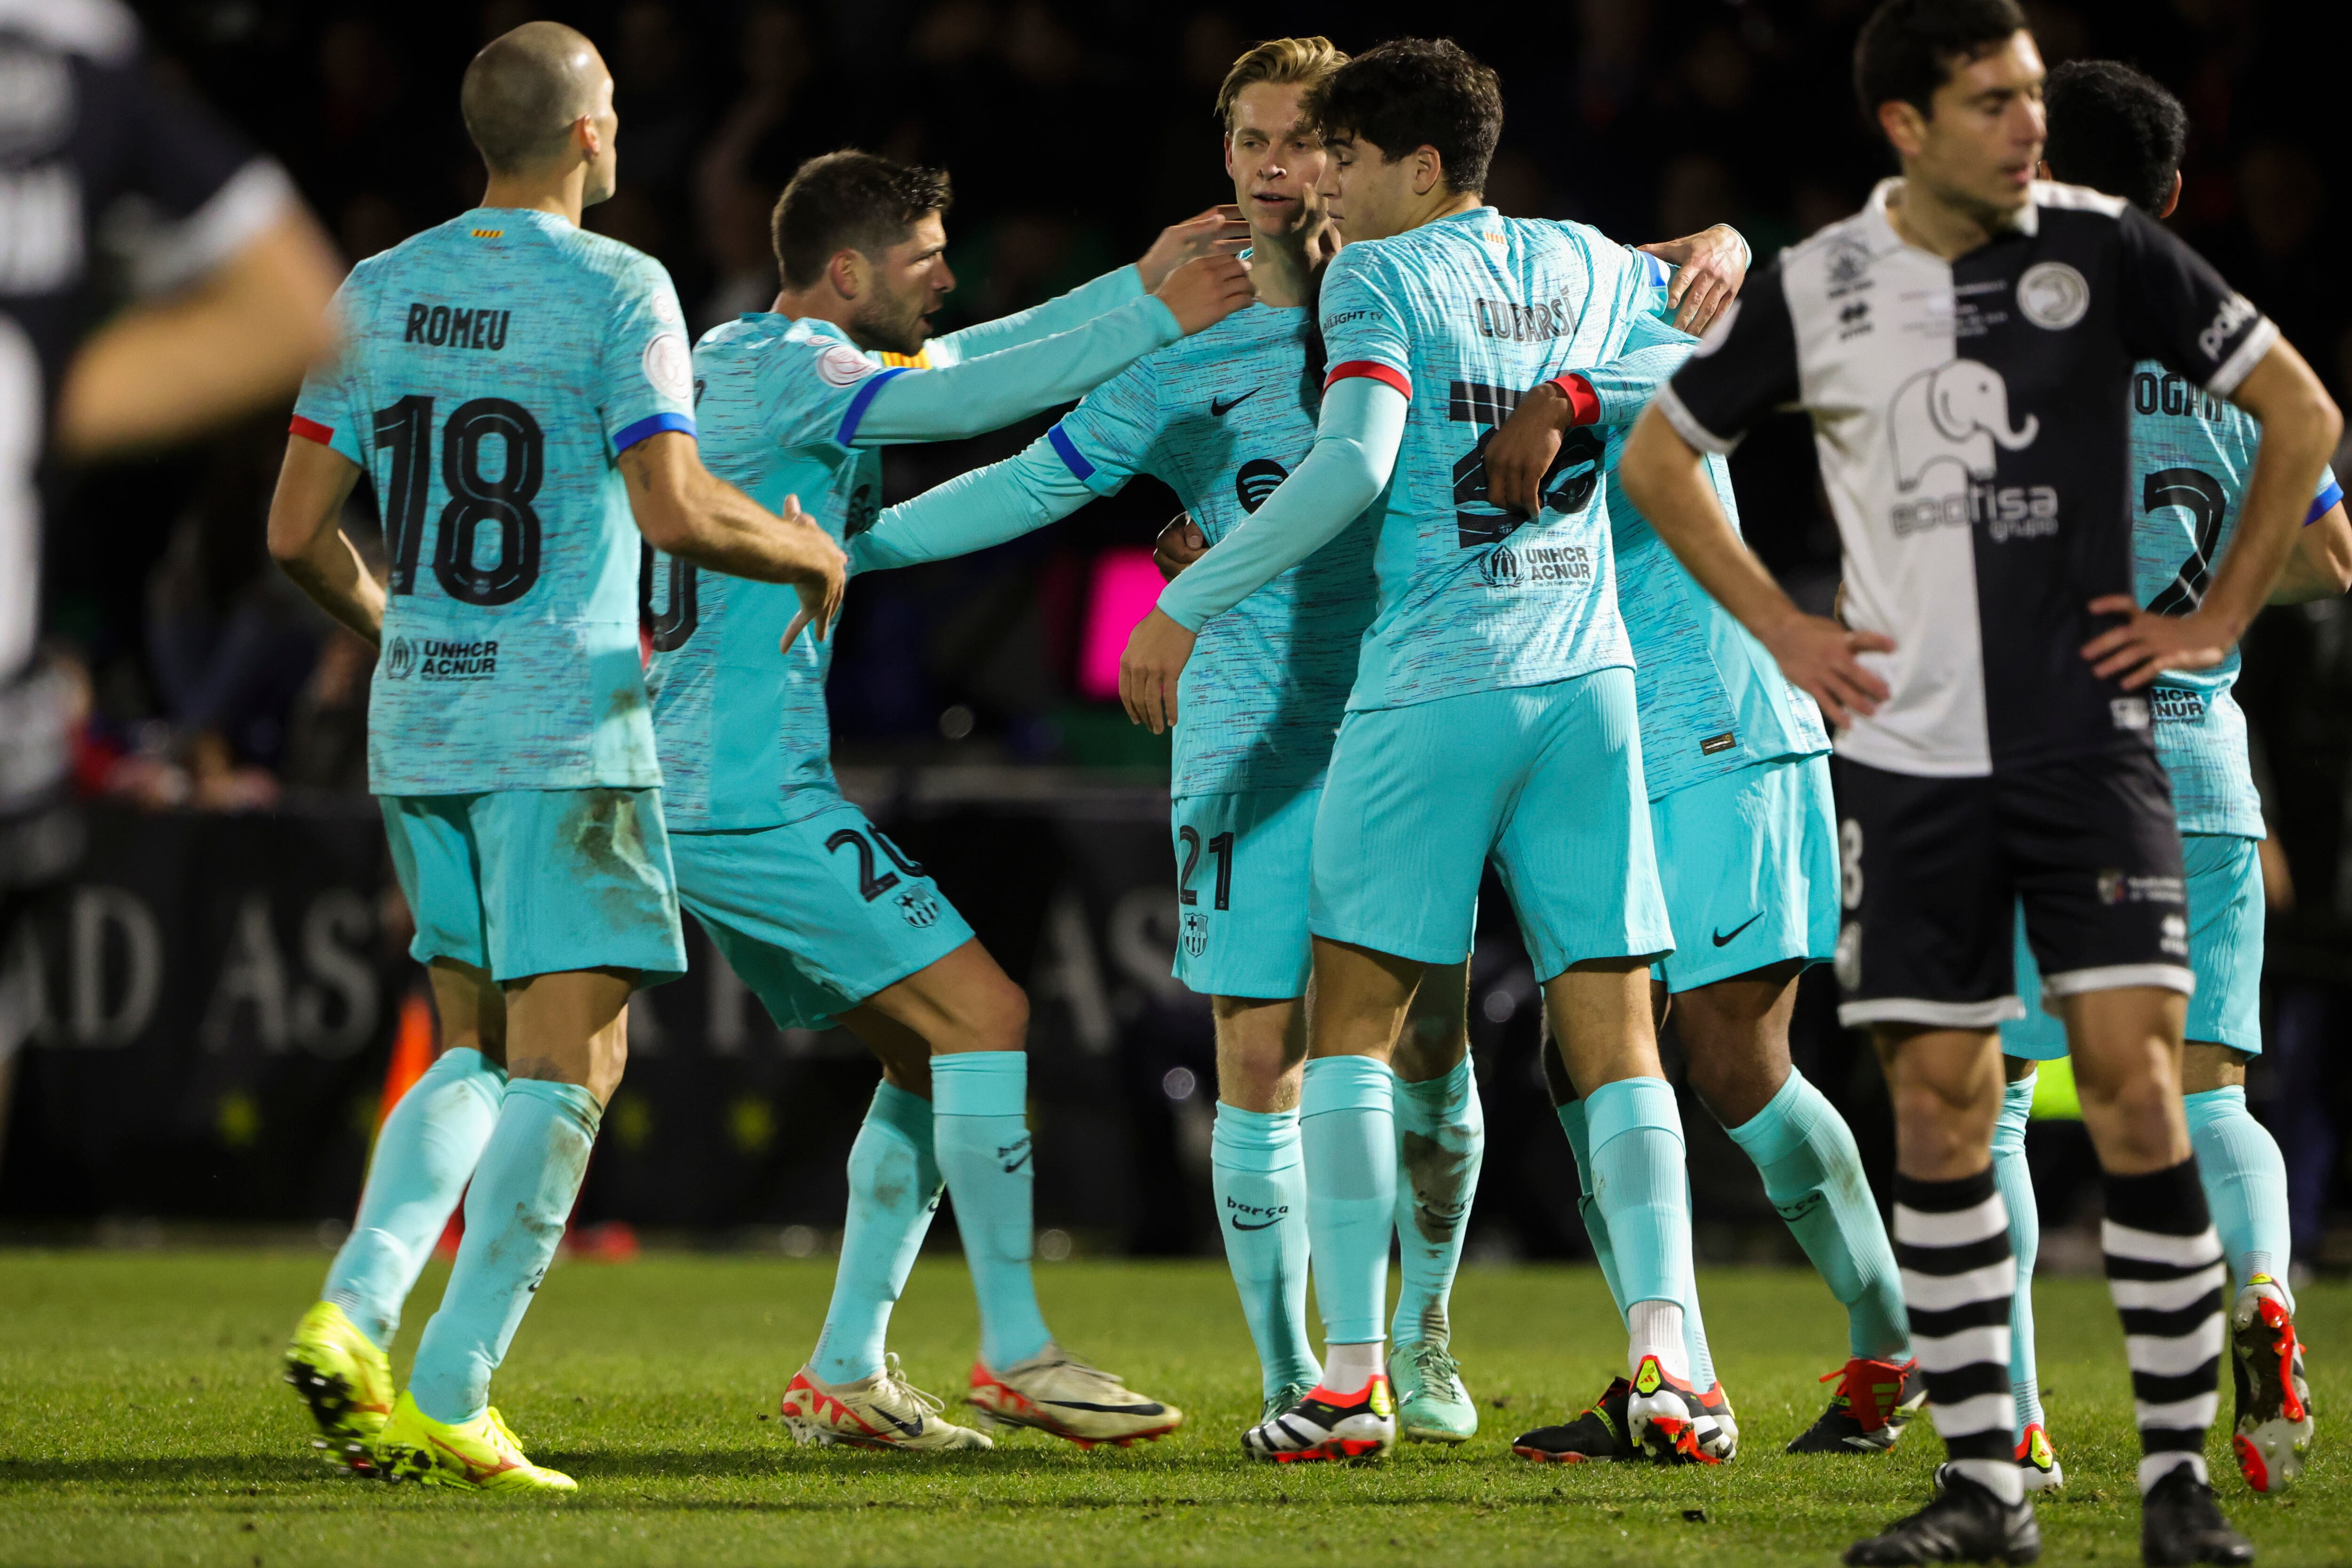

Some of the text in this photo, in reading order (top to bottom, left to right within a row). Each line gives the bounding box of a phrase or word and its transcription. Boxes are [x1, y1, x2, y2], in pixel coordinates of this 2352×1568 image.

[405, 302, 511, 351] ROMEU
[373, 394, 546, 607] 18
[1526, 547, 1589, 564] UNHCR
[1532, 564, 1591, 580] ACNUR
[424, 640, 499, 657] UNHCR
[421, 657, 497, 674] ACNUR
[1179, 825, 1234, 911] 21
[1227, 1196, 1288, 1218] barça
